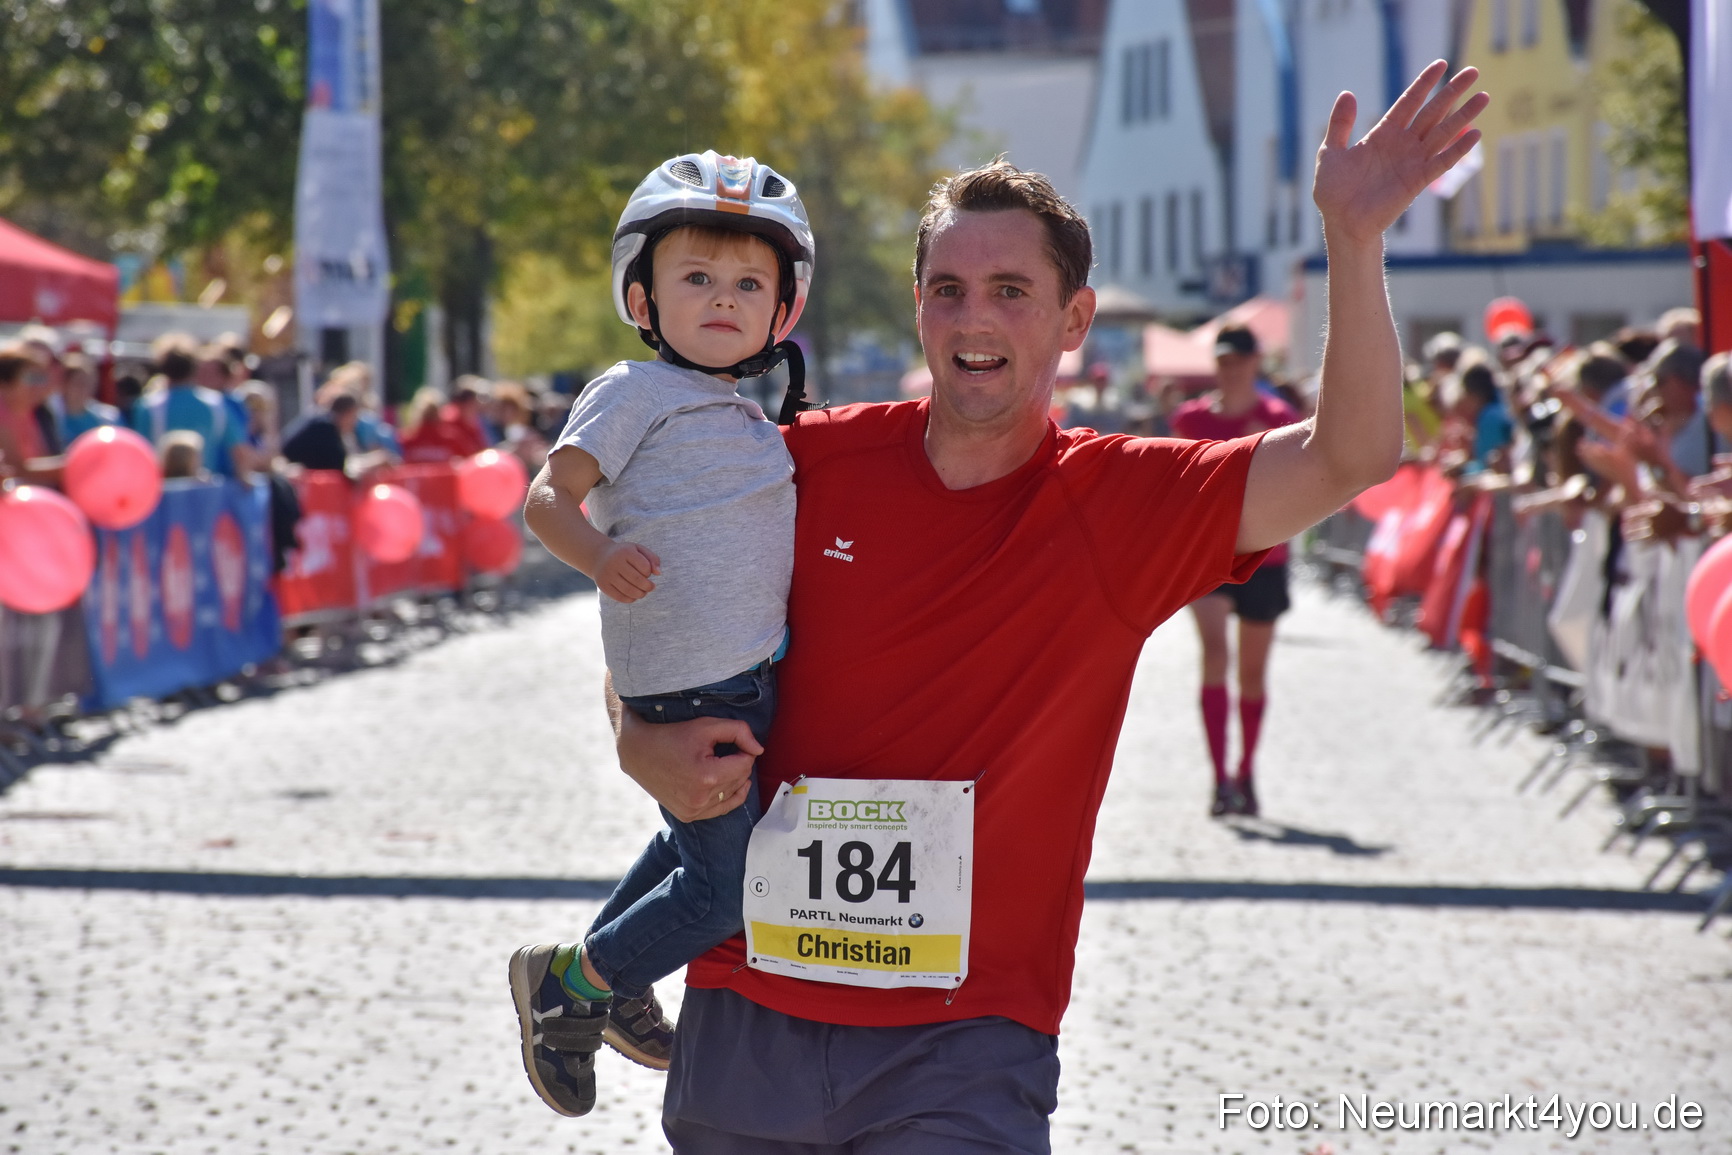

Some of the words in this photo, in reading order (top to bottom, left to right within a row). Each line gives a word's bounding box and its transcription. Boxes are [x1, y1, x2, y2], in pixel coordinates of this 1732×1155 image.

[823, 548, 854, 562] erima
[807, 800, 906, 823] BOCK
[807, 822, 837, 830] inspired
[839, 823, 849, 831] by
[874, 823, 908, 831] concepts
[797, 839, 916, 904] 184
[755, 881, 763, 893] C
[790, 908, 836, 922] PARTL
[839, 912, 903, 926] Neumarkt
[797, 933, 911, 966] Christian
